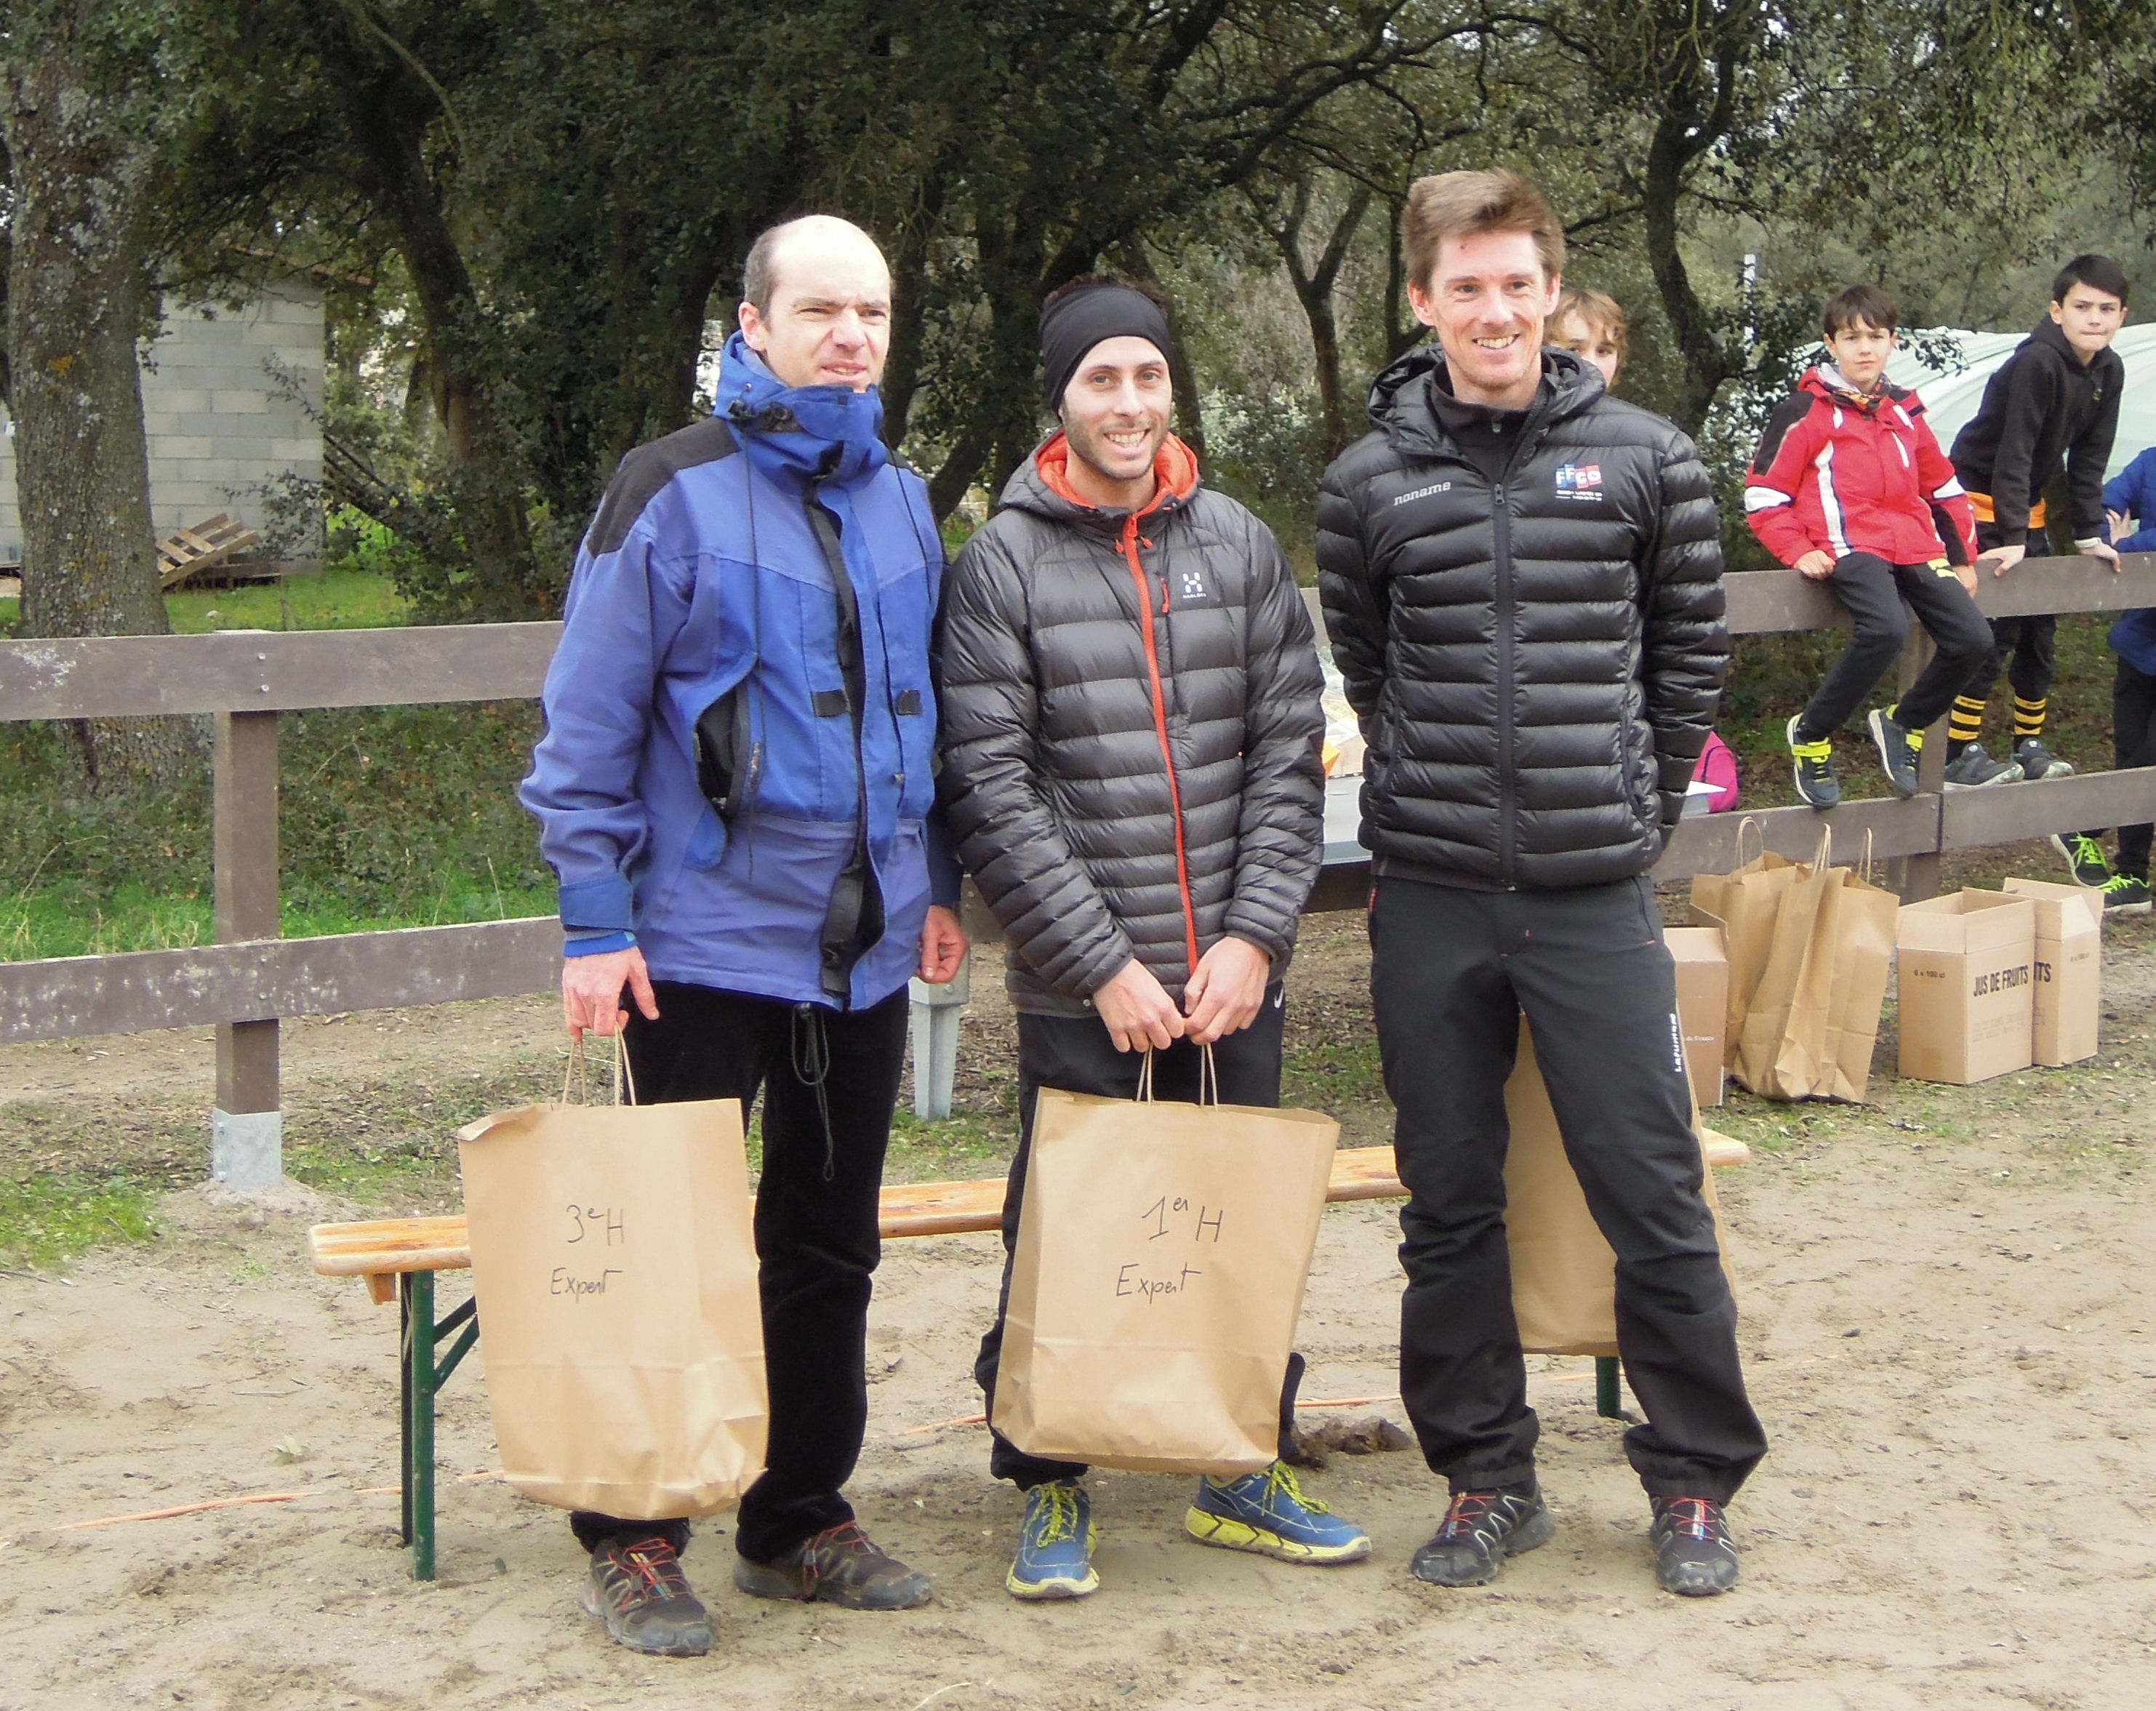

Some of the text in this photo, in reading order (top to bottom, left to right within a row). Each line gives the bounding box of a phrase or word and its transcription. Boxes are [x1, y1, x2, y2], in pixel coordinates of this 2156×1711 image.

[1393, 481, 1451, 506] noname
[1973, 964, 2029, 997] JUS DE FRUITS
[1195, 1205, 1224, 1243] H
[550, 1267, 623, 1304] Expert
[1115, 1262, 1203, 1305] Expert
